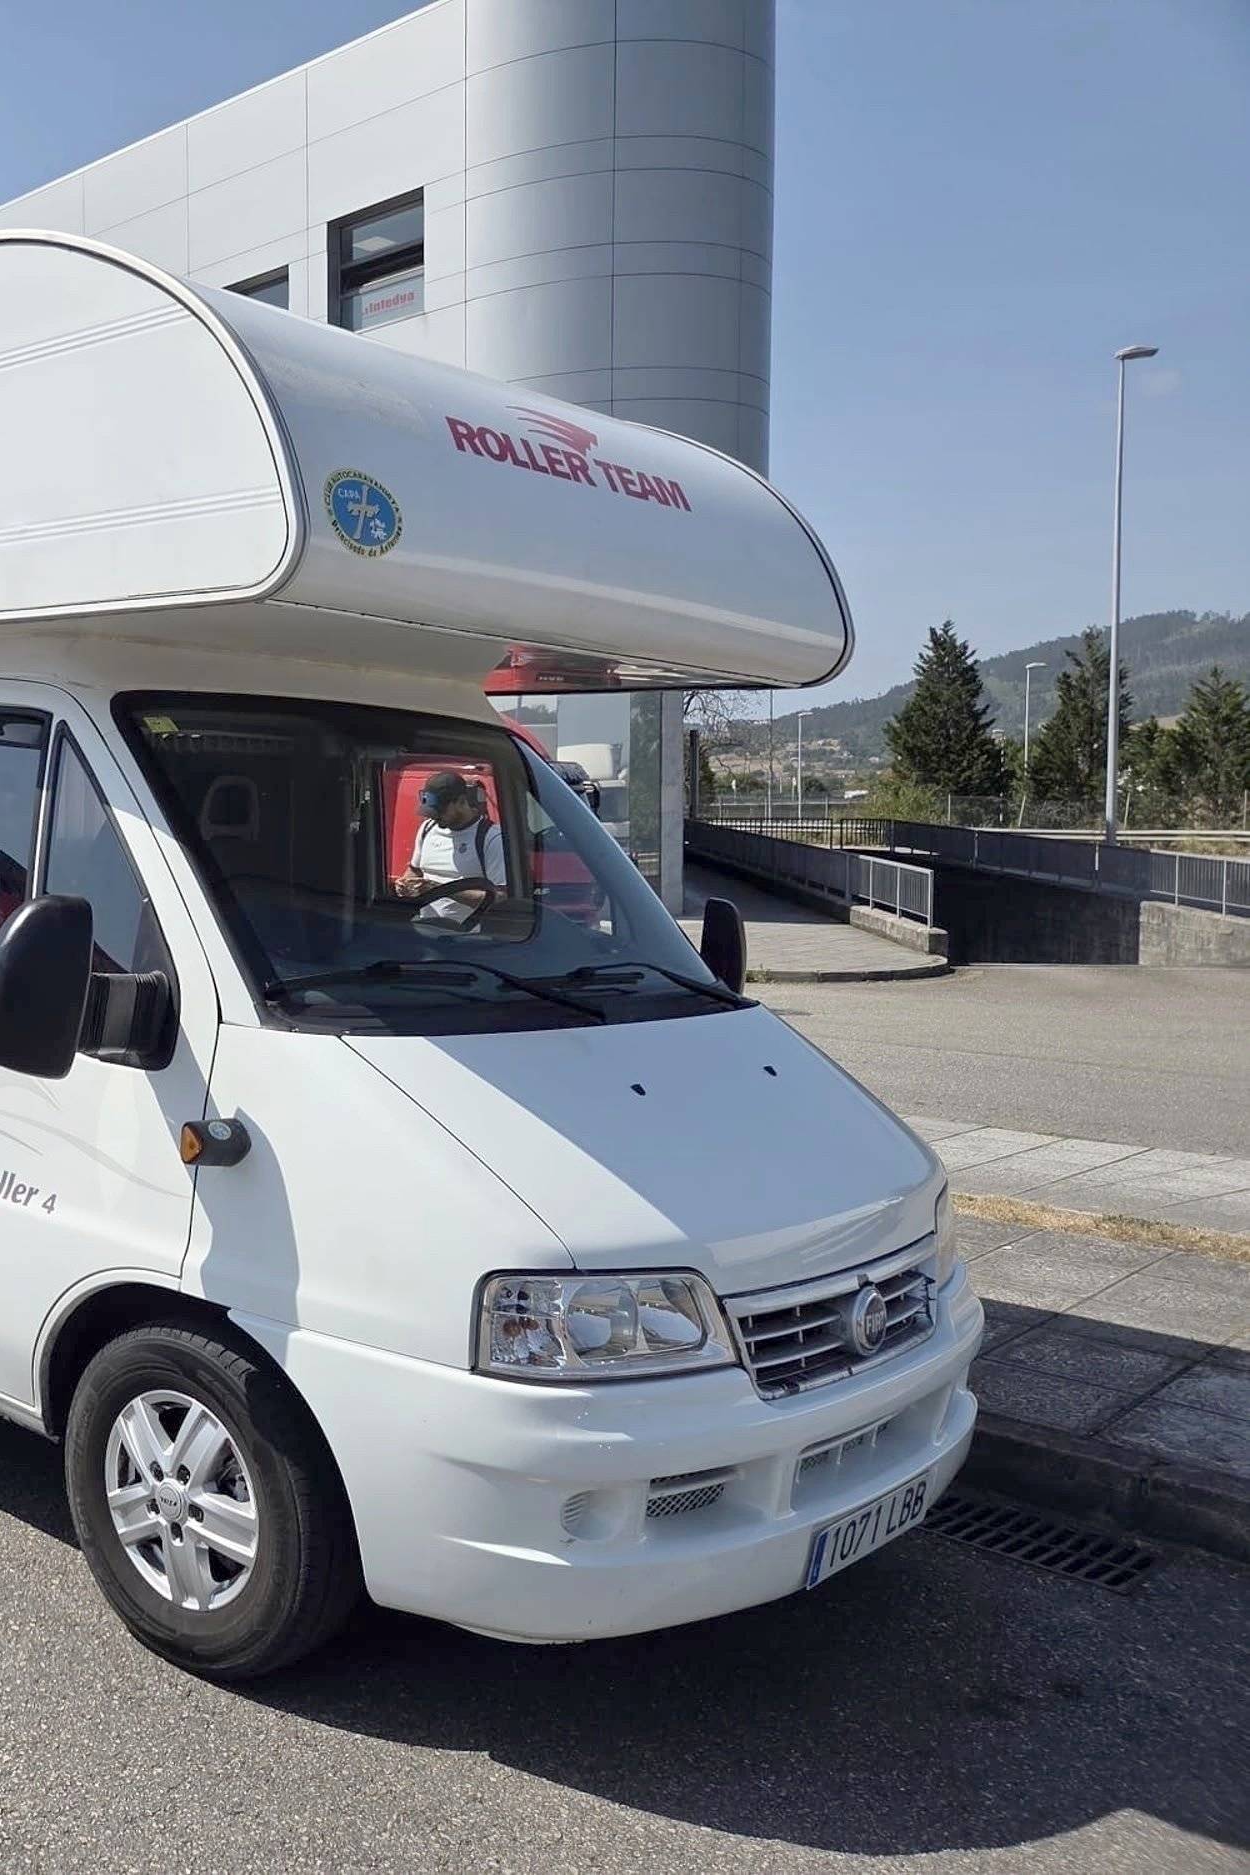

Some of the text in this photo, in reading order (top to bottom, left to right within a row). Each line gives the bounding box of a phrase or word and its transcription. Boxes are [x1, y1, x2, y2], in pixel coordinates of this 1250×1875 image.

[445, 416, 692, 512] ROLLER TEAM
[42, 1194, 58, 1214] 4
[865, 1310, 885, 1336] FIAT
[830, 1480, 927, 1568] 1071 LBB
